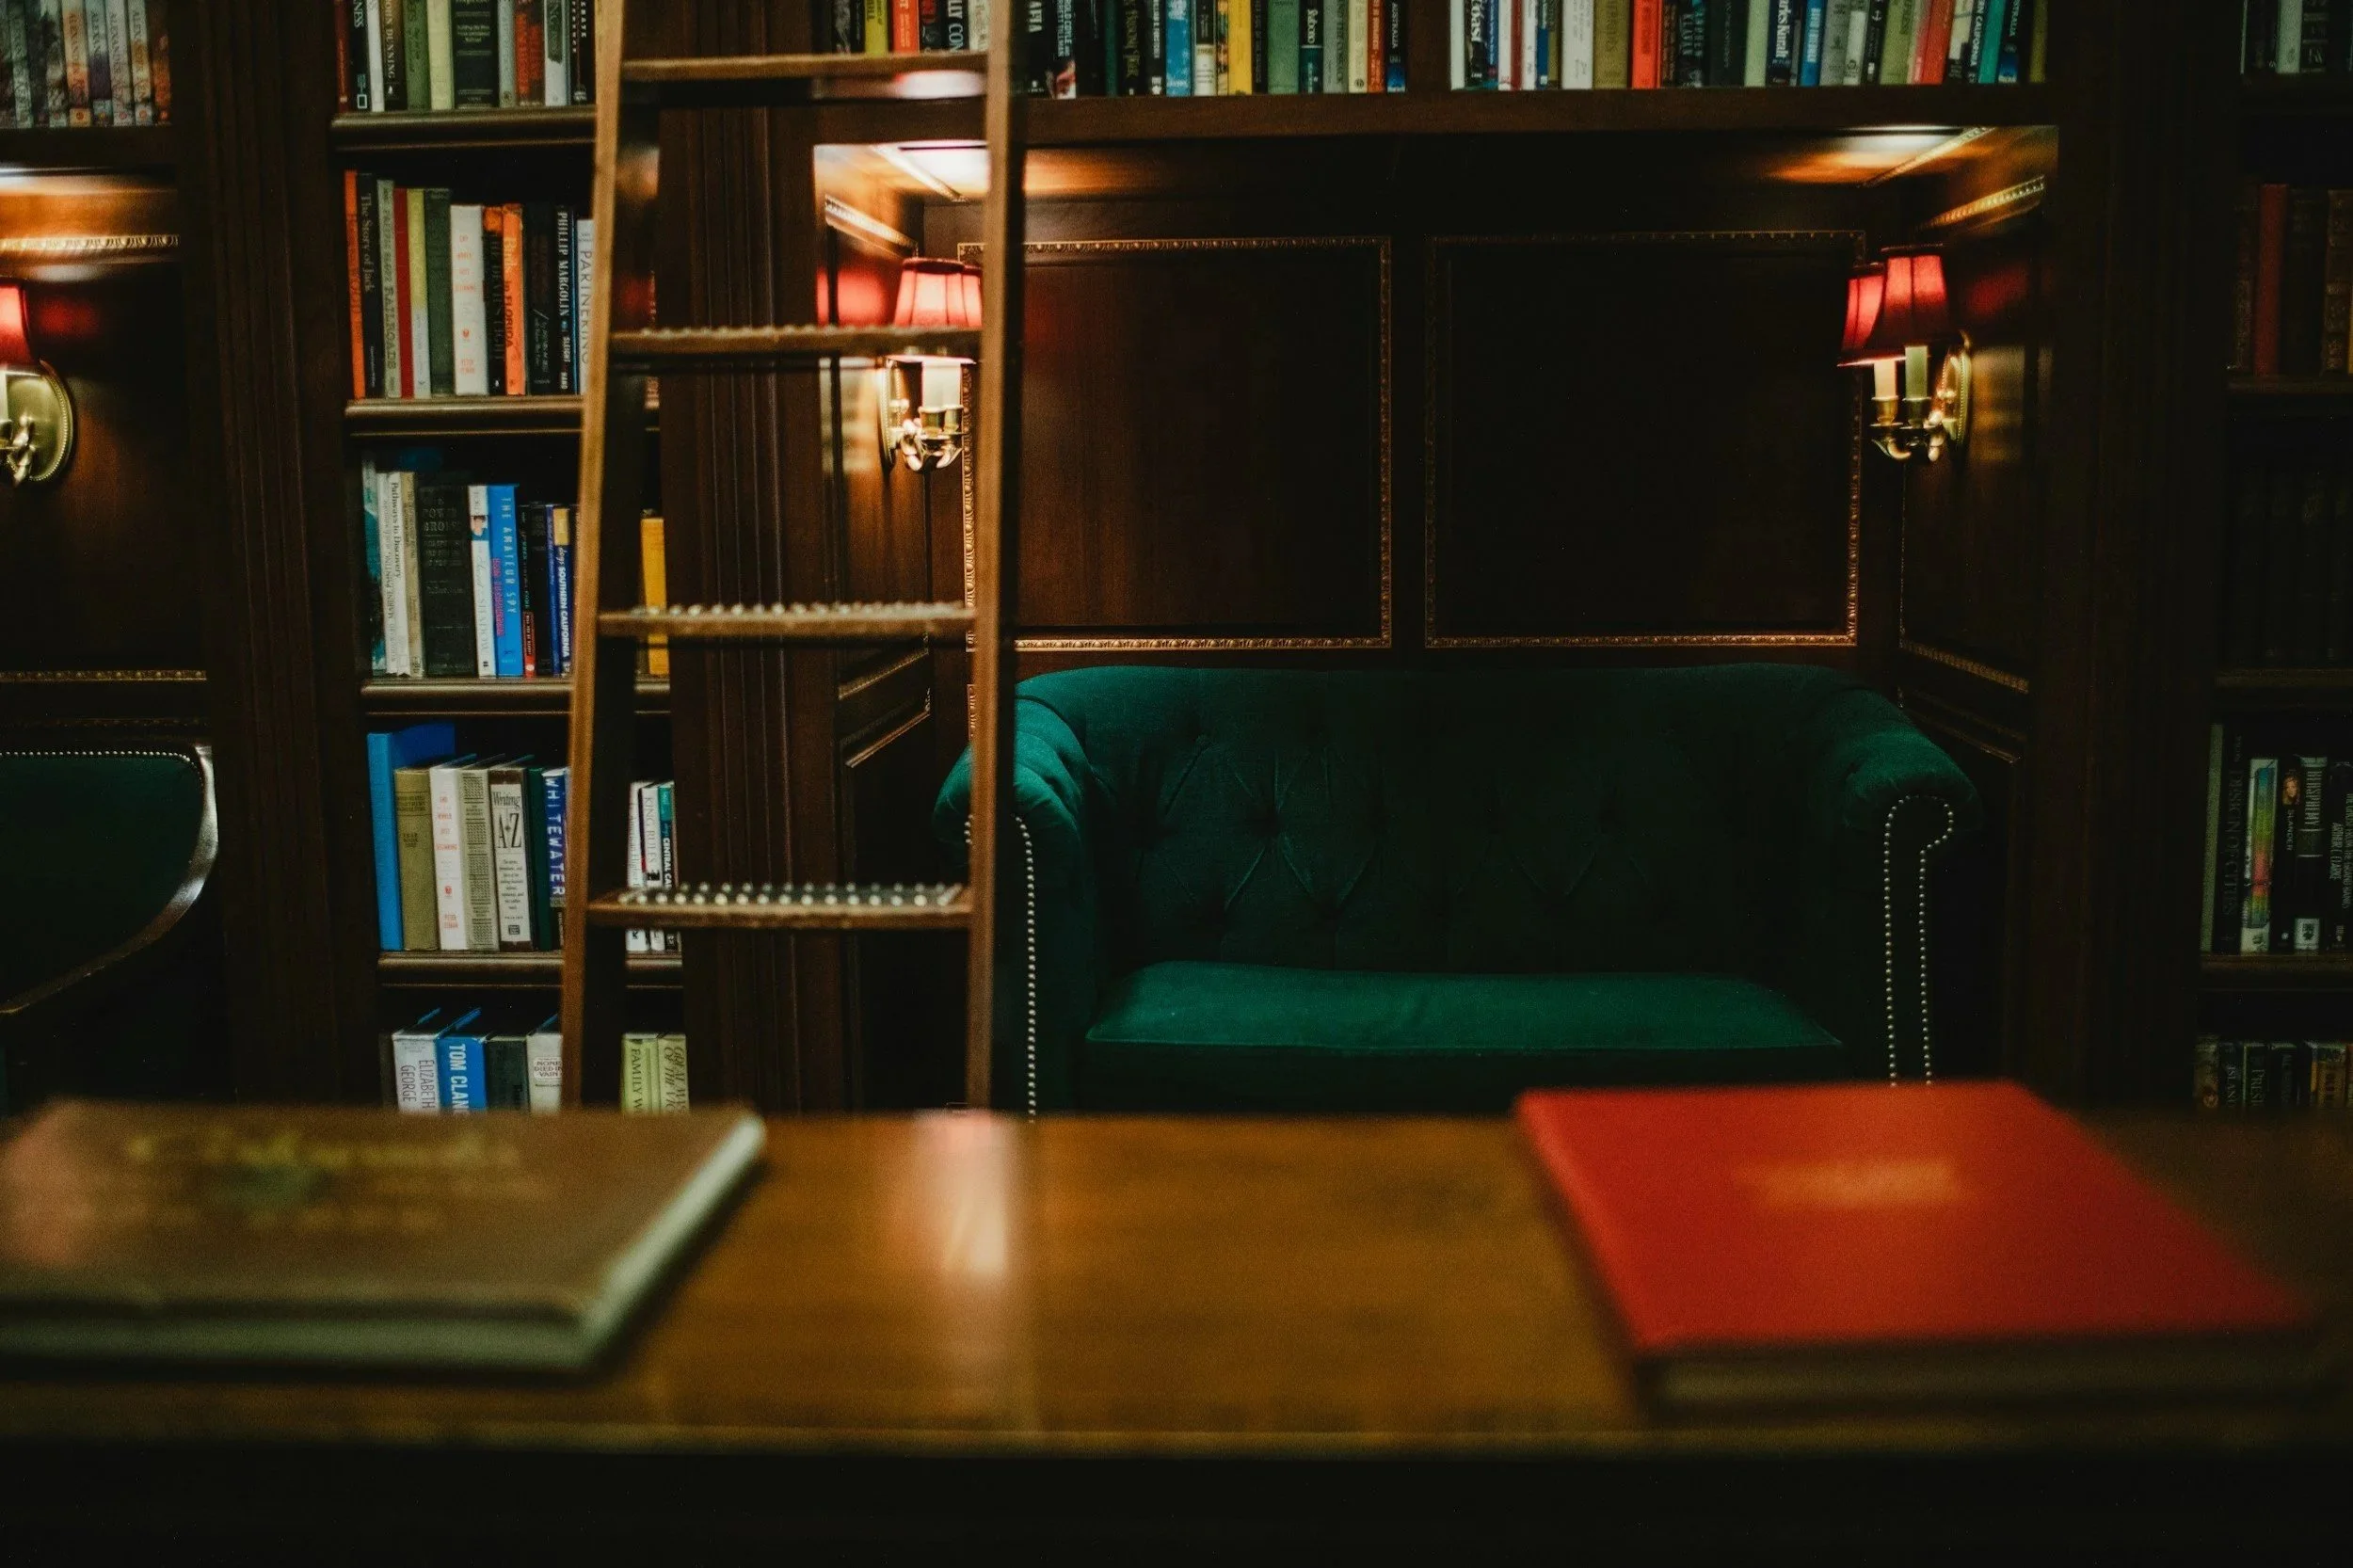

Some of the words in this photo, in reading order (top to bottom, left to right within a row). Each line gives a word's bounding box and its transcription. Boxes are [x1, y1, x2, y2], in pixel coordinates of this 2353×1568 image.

[1392, 2, 1401, 50] AUSTRALIA
[1775, 25, 1790, 59] Kuralt
[1970, 15, 1983, 68] CALIFORNIA
[387, 29, 395, 79] DUNNING
[360, 193, 372, 216] The
[361, 219, 374, 250] Story
[557, 212, 569, 256] PHILLIP
[363, 253, 374, 267] of
[364, 268, 376, 294] Jack
[558, 259, 570, 317] MARGOLIN
[385, 286, 396, 371] RAILROADS
[505, 296, 514, 348] FLORIDA
[562, 336, 570, 364] SLEIGHT
[391, 482, 401, 524] Pathways
[501, 498, 512, 520] THE
[392, 536, 403, 579] Discovery
[503, 527, 517, 584] AMATEUR
[506, 592, 517, 615] SPY
[557, 567, 568, 609] SOUTHERN
[559, 612, 570, 657] CALIFORNIA
[492, 792, 521, 810] Writing
[546, 777, 565, 896] WHITEWATER
[2285, 809, 2296, 852] SLANDER
[2331, 822, 2344, 850] ARTHUR
[663, 837, 672, 872] CENTRAL
[2329, 856, 2342, 881] CLARKE
[448, 1044, 467, 1071] TOM
[632, 1048, 643, 1095] FAMILY
[400, 1064, 418, 1103] GEORGE
[419, 1059, 437, 1110] ELIZABETH
